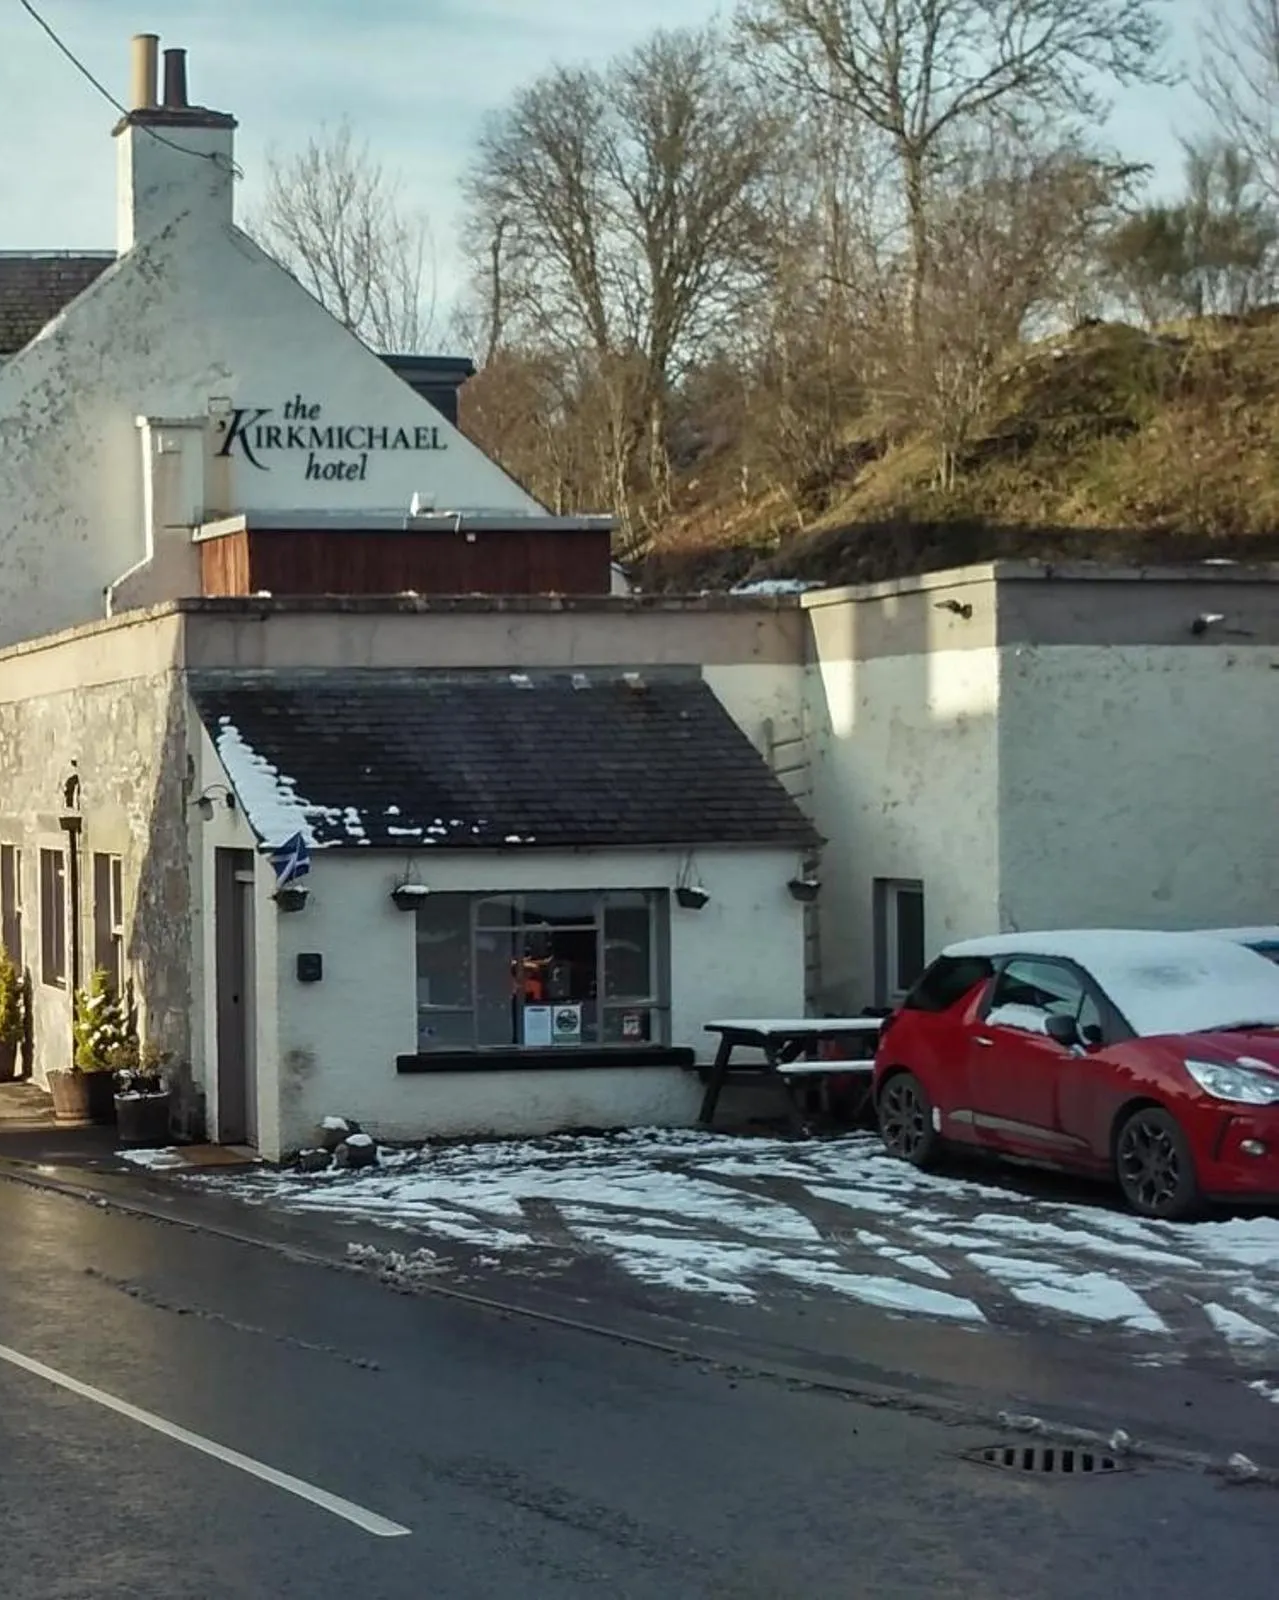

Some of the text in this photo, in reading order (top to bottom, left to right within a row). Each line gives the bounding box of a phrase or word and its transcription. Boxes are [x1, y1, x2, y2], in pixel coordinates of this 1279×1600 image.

[284, 395, 321, 420] the
[215, 408, 448, 470] KIRKMICHAEL
[305, 452, 368, 480] hotel
